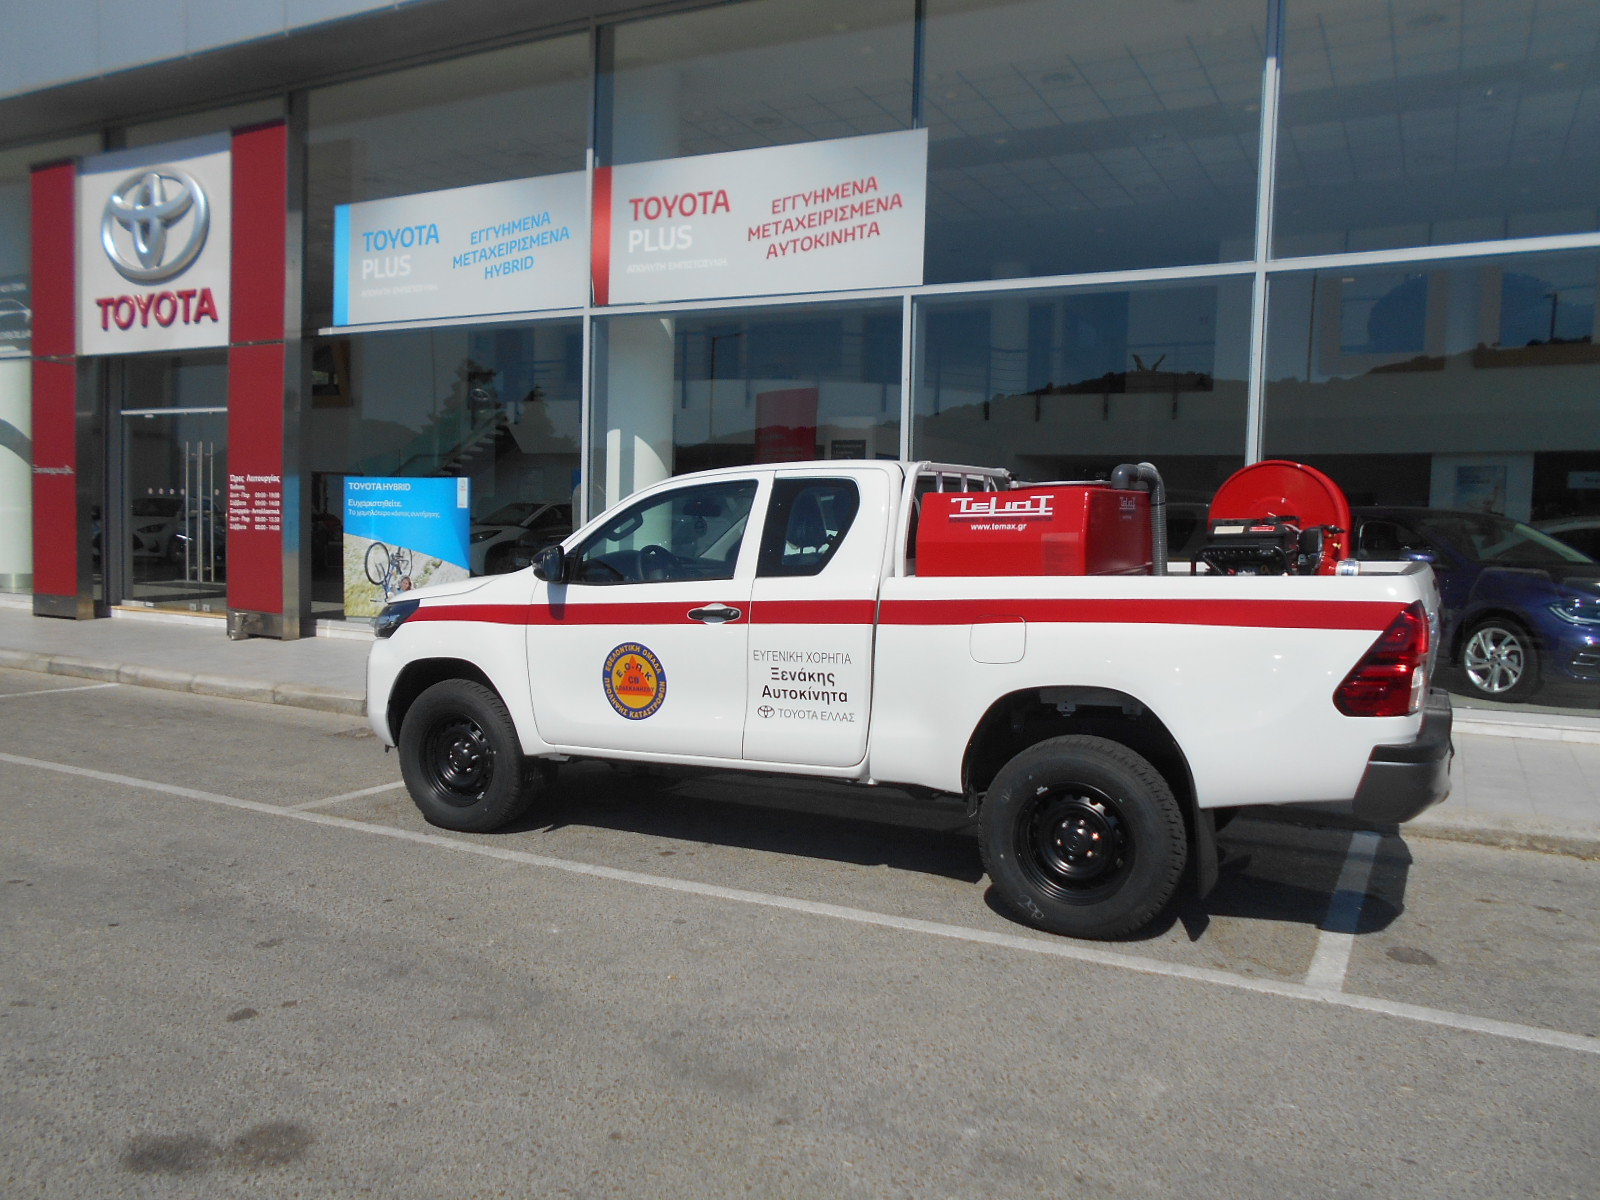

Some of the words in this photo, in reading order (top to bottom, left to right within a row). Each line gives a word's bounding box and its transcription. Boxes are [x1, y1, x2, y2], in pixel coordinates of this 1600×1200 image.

[629, 189, 730, 221] TOYOTA
[771, 175, 878, 215] ΕΓΓΥΗΜΕΝΑ
[470, 211, 551, 245] ΕΓΓΥΗΜΕΝΑ
[747, 192, 903, 241] ΜΕΤΑΧΕΙΡΙΣΜΕΝΑ
[363, 223, 440, 252] TOYOTA
[453, 226, 570, 269] ΜΕΤΑΧΕΙΡΙΣΜΕΝΑ
[628, 225, 693, 253] PLUS
[766, 221, 881, 260] ΑΥΤΟΚΙΝΗΤΑ
[362, 255, 412, 280] PLUS
[484, 255, 534, 280] HYBRID
[95, 287, 219, 331] TOYOTA
[348, 482, 382, 491] TOYOTA
[383, 483, 411, 491] HYBRID
[970, 523, 1027, 532] www.temax.gr
[753, 649, 803, 662] ΕΥΓΕΝΙΚΗ
[805, 652, 852, 664] ΧΟΡΗΓΙΑ
[770, 667, 835, 687] Ξενάκης
[762, 685, 848, 705] Αυτοκίνητα
[778, 708, 818, 720] TOYOTA
[820, 711, 855, 722] ΕΛΛΑΣ
